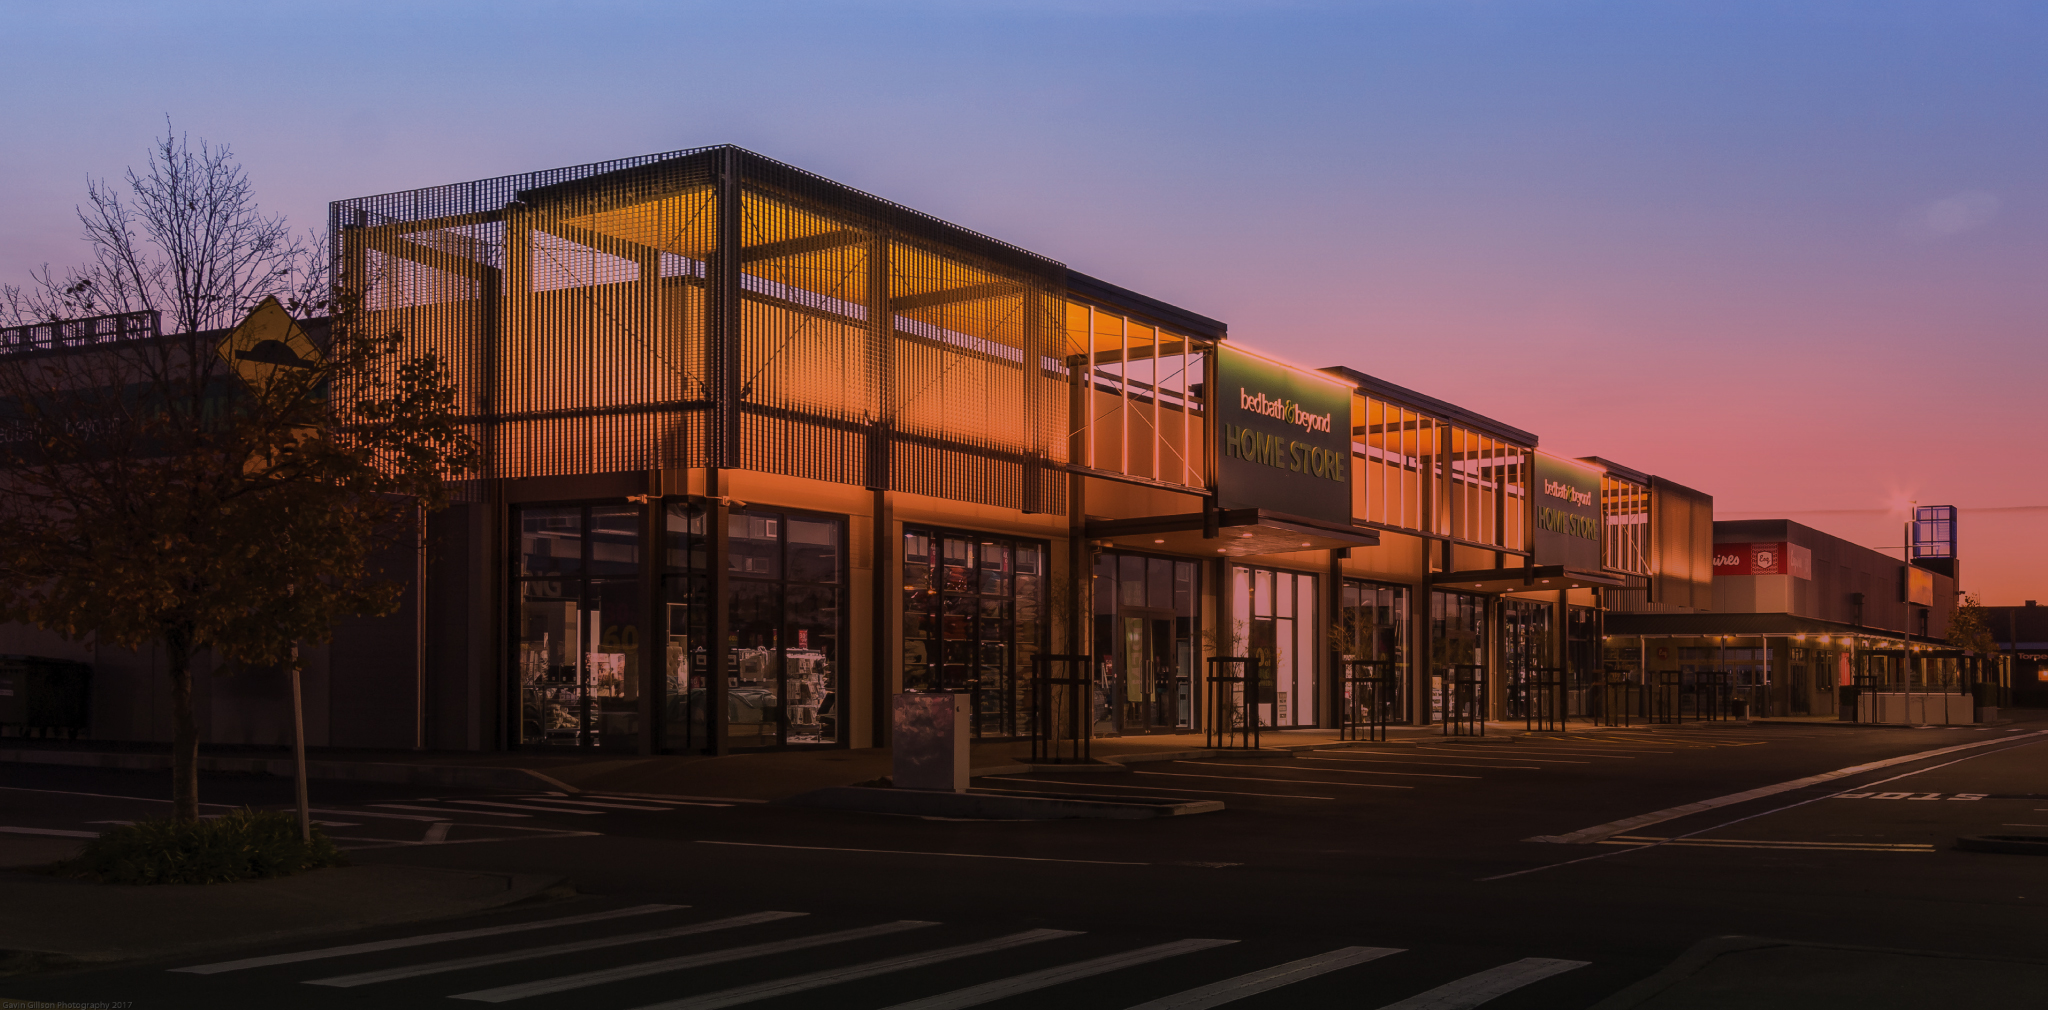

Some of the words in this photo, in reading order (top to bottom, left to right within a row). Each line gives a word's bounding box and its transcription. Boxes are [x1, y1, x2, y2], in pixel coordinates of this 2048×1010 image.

[1225, 423, 1285, 469] HOME
[1290, 440, 1345, 483] STORE
[1537, 505, 1568, 534] HOME
[1569, 513, 1598, 541] STORE
